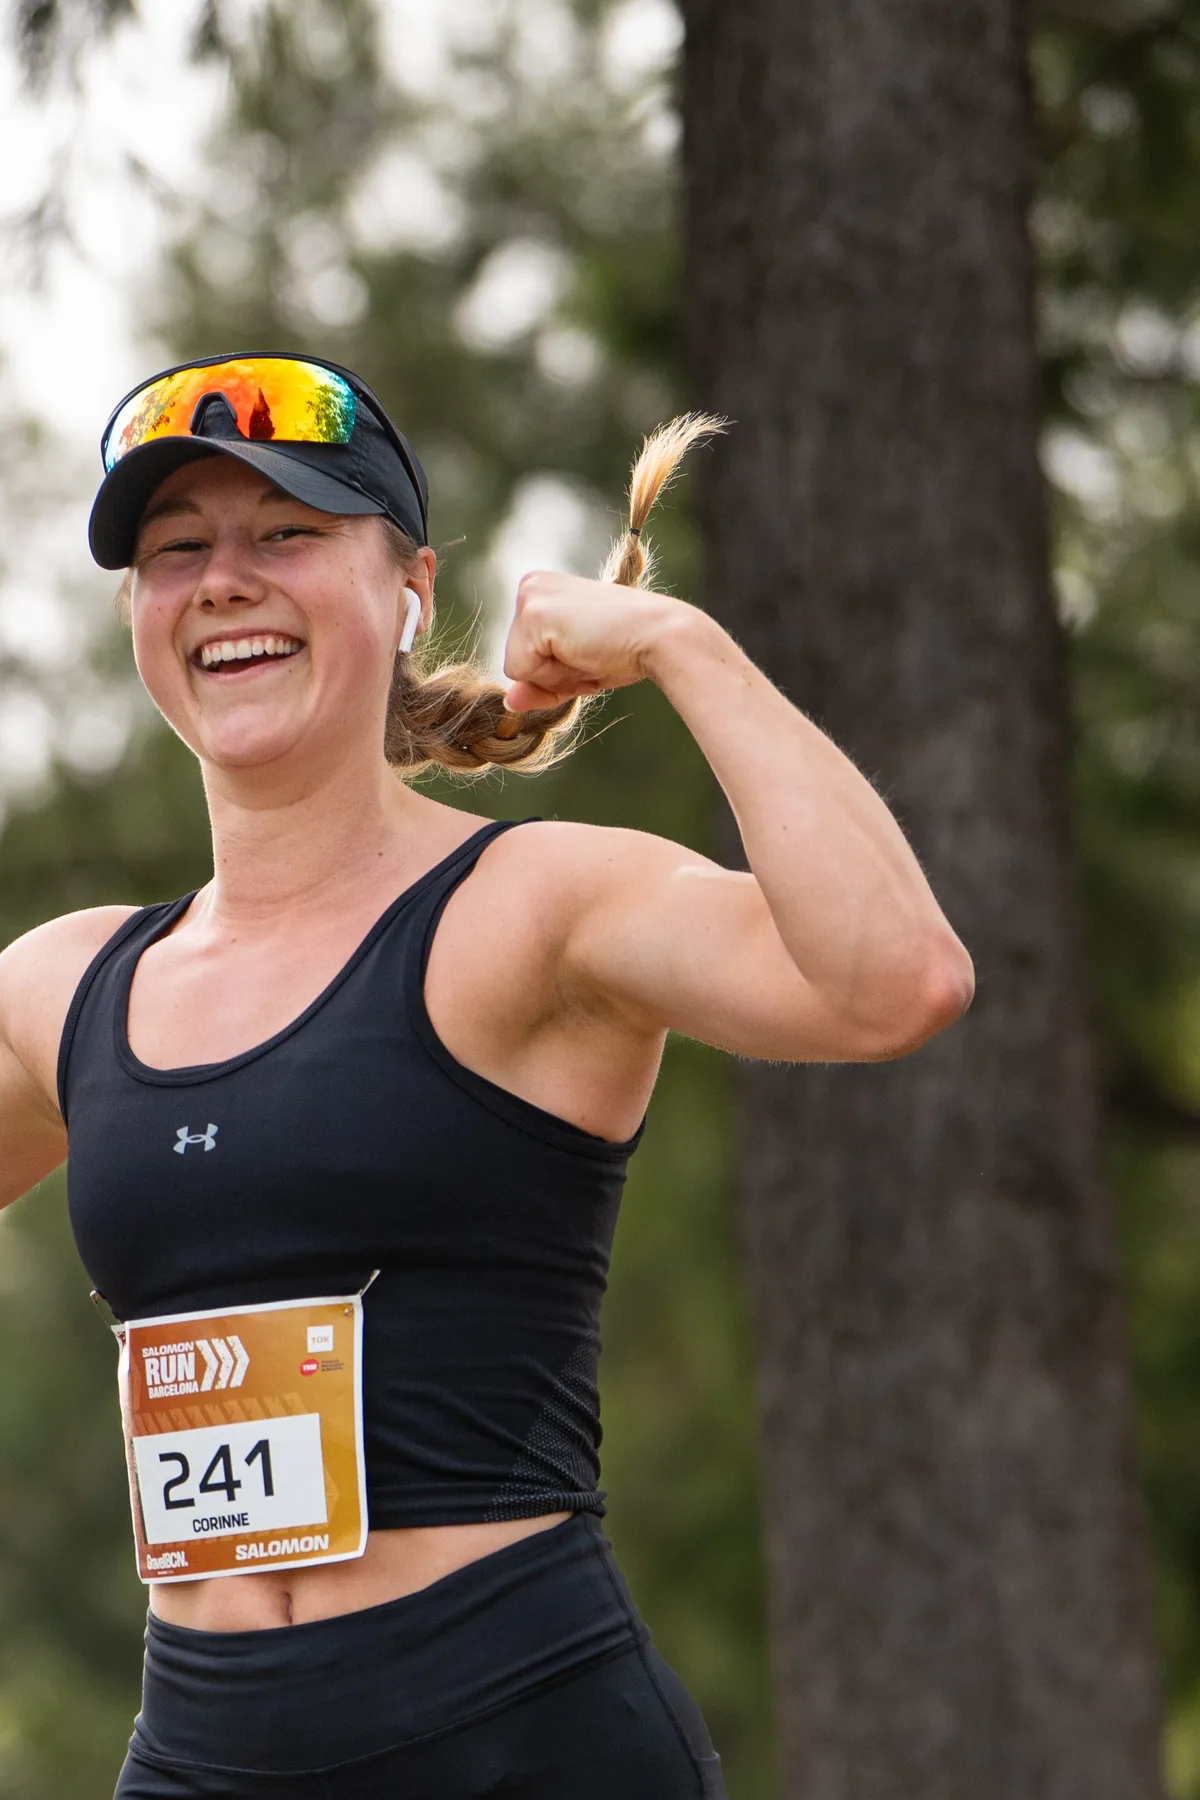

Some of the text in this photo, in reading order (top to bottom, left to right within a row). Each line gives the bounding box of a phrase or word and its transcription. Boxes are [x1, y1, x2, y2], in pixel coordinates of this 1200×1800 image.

[142, 1341, 194, 1358] SALOMON
[145, 1352, 195, 1387] RUN
[148, 1380, 199, 1399] BARCELONA
[158, 1439, 275, 1510] 241
[192, 1512, 250, 1533] CORINNE
[235, 1534, 330, 1561] SALOMON
